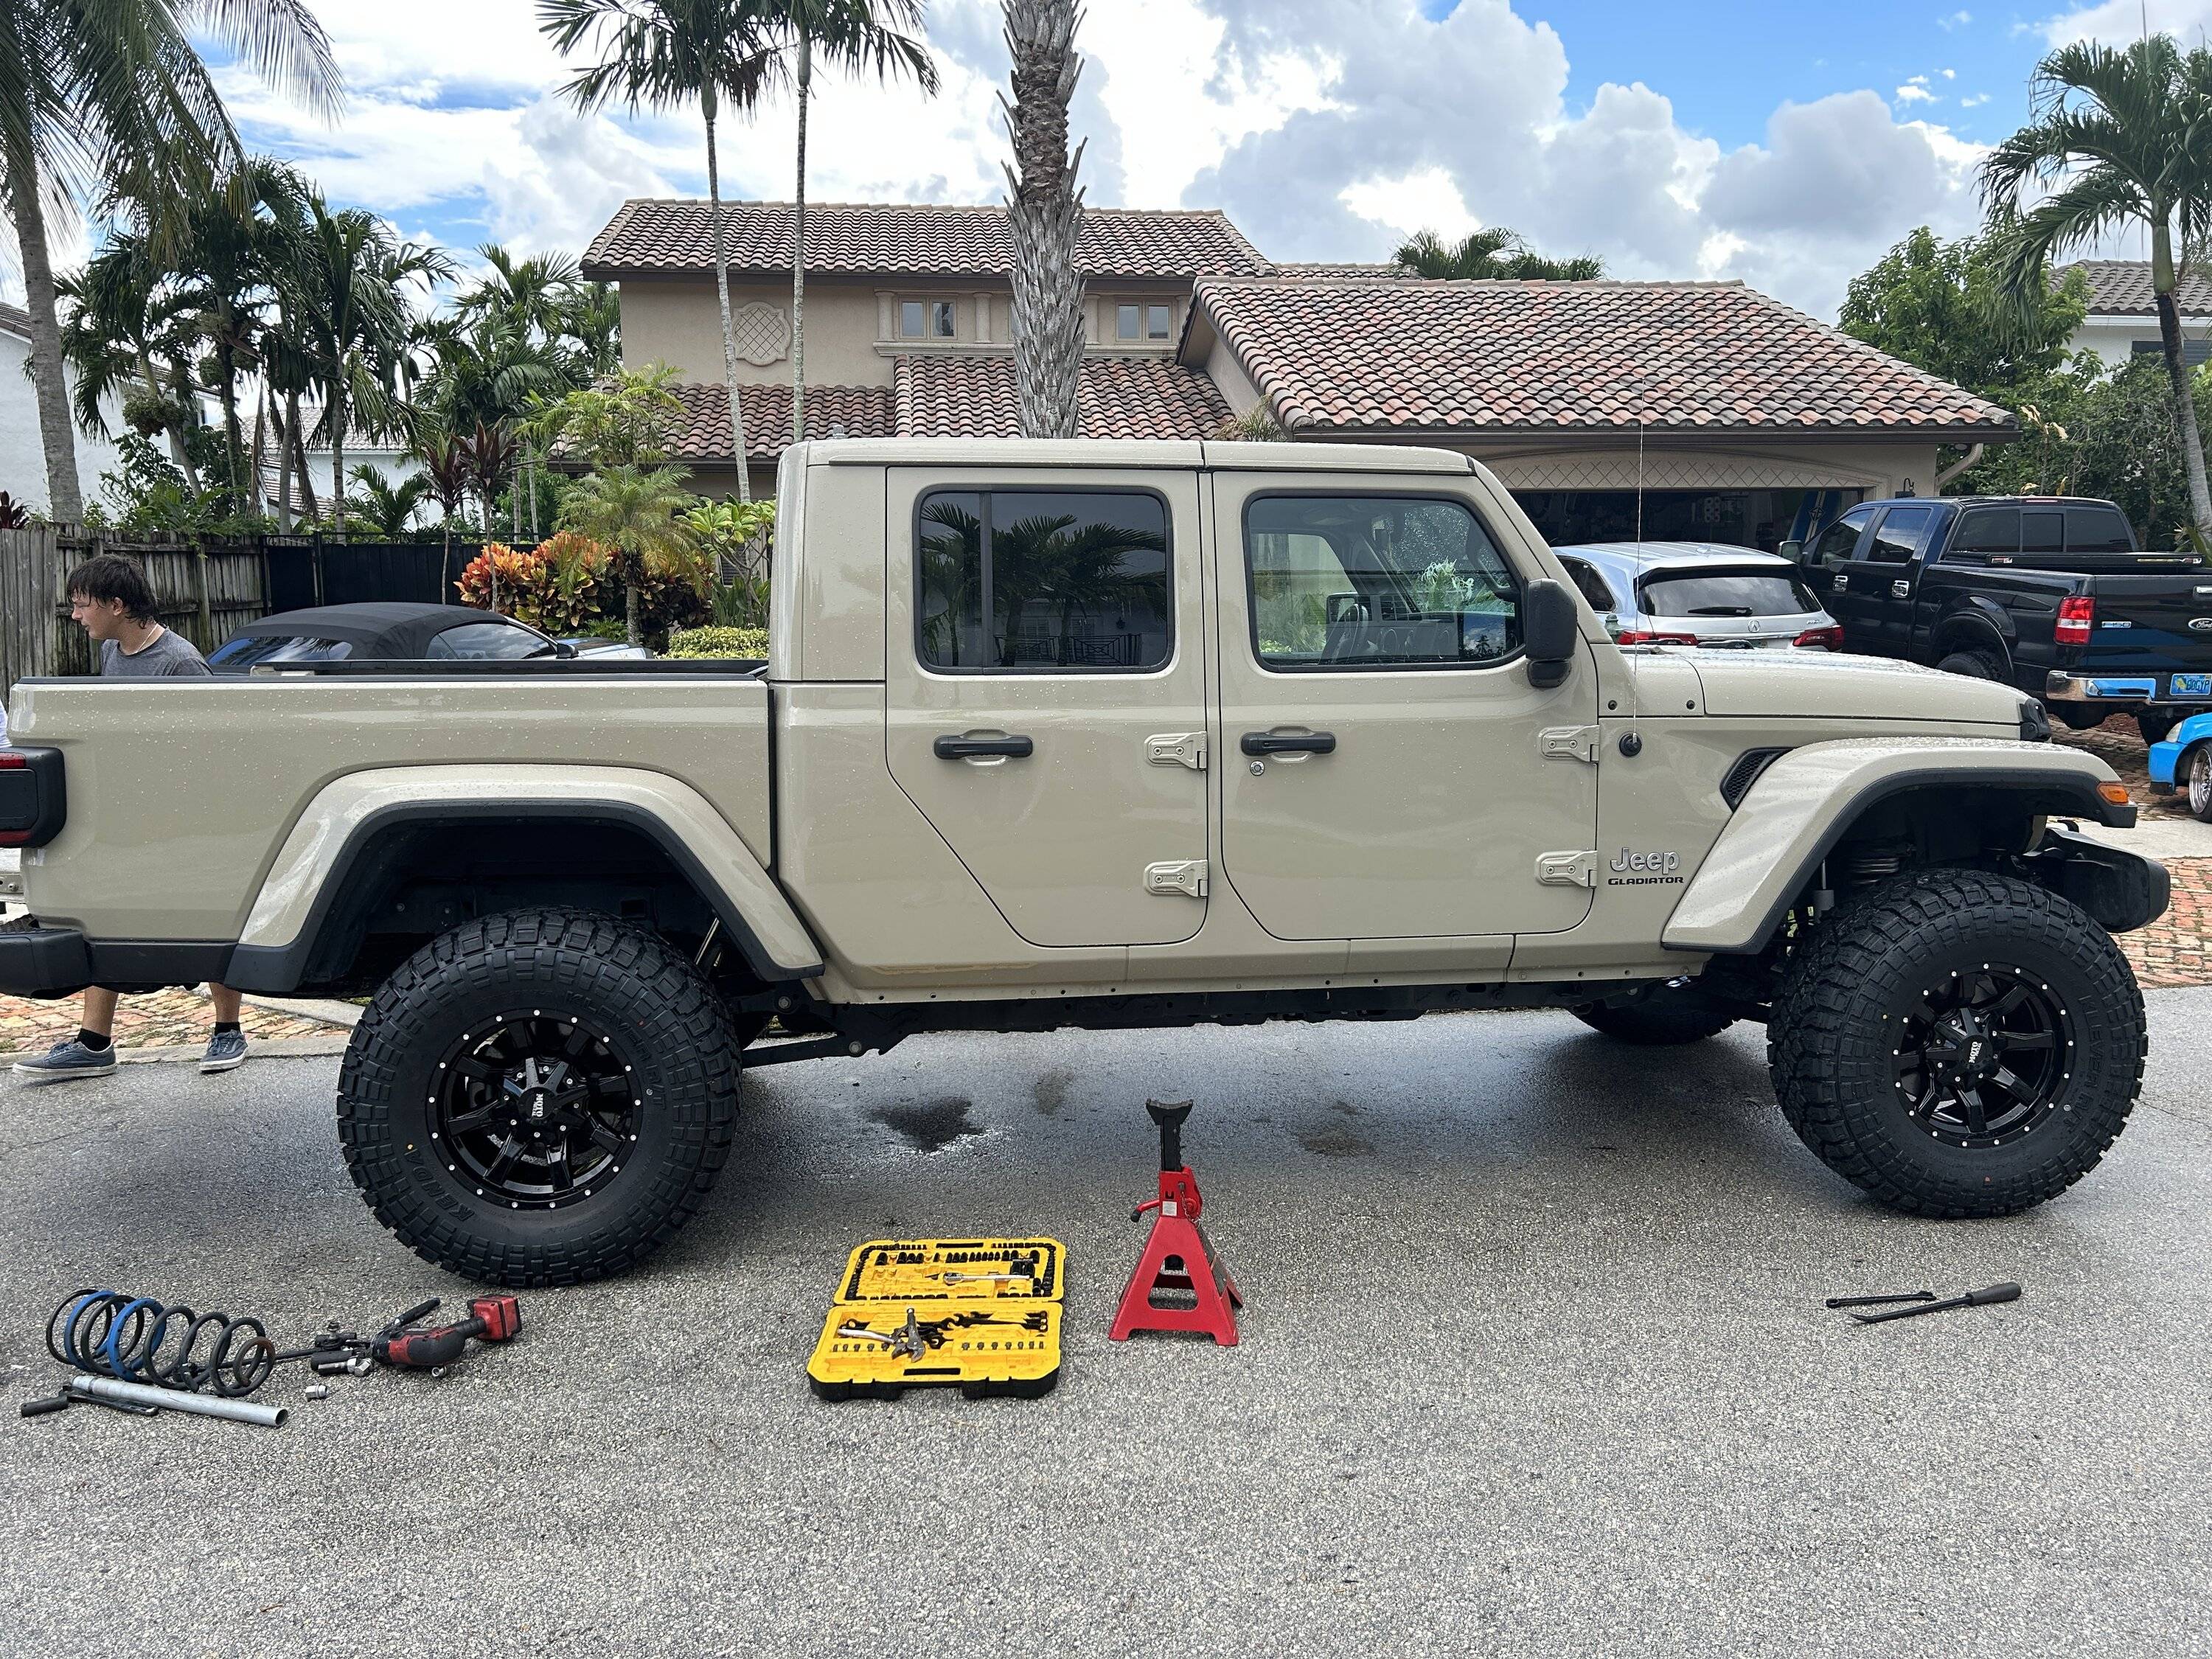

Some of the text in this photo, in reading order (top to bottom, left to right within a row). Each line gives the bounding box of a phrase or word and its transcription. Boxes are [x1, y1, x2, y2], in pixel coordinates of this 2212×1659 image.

[1610, 847, 1680, 875] Jeep
[1608, 877, 1683, 886] GLADIATOR
[565, 990, 652, 1062] KLEVER
[1969, 1041, 1978, 1063] MOTO
[535, 1093, 543, 1117] MOTO
[403, 1148, 476, 1222] KENDA
